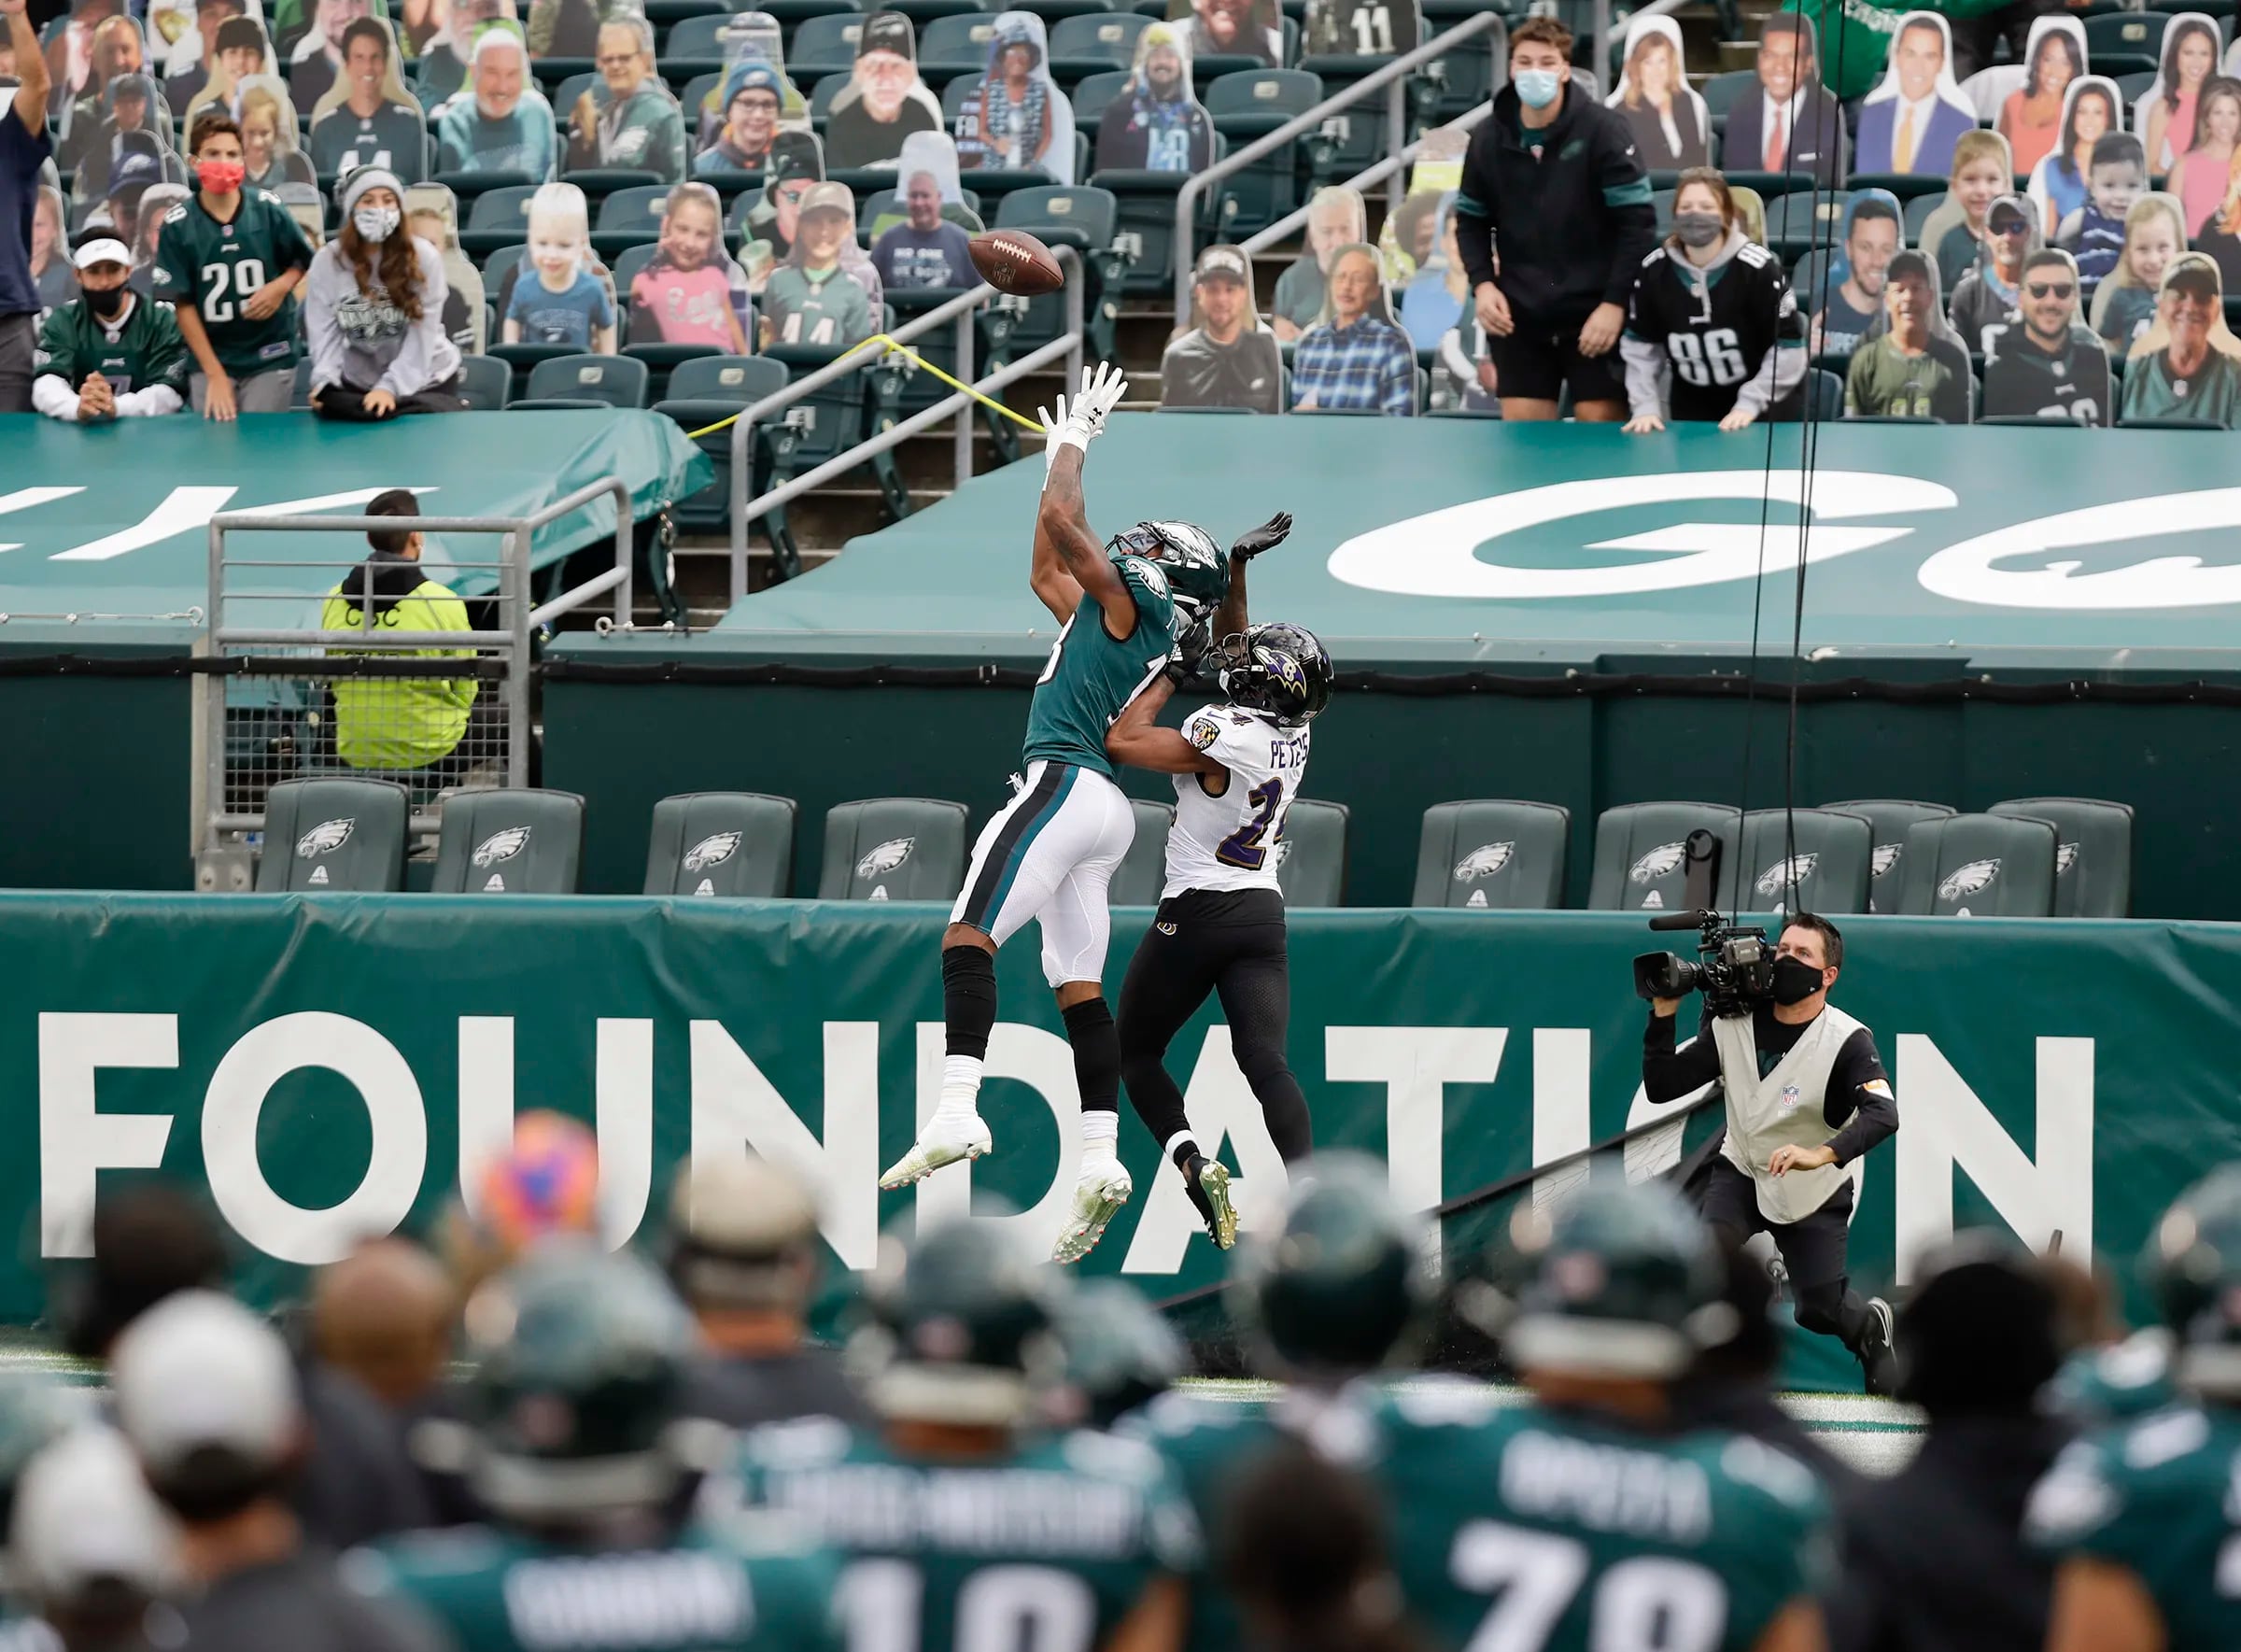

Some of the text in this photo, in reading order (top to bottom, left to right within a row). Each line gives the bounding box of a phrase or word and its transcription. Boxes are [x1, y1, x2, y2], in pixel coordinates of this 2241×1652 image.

[1350, 6, 1397, 55] 11
[202, 259, 265, 322] 29
[1668, 328, 1747, 387] 86
[1215, 776, 1291, 870] 2
